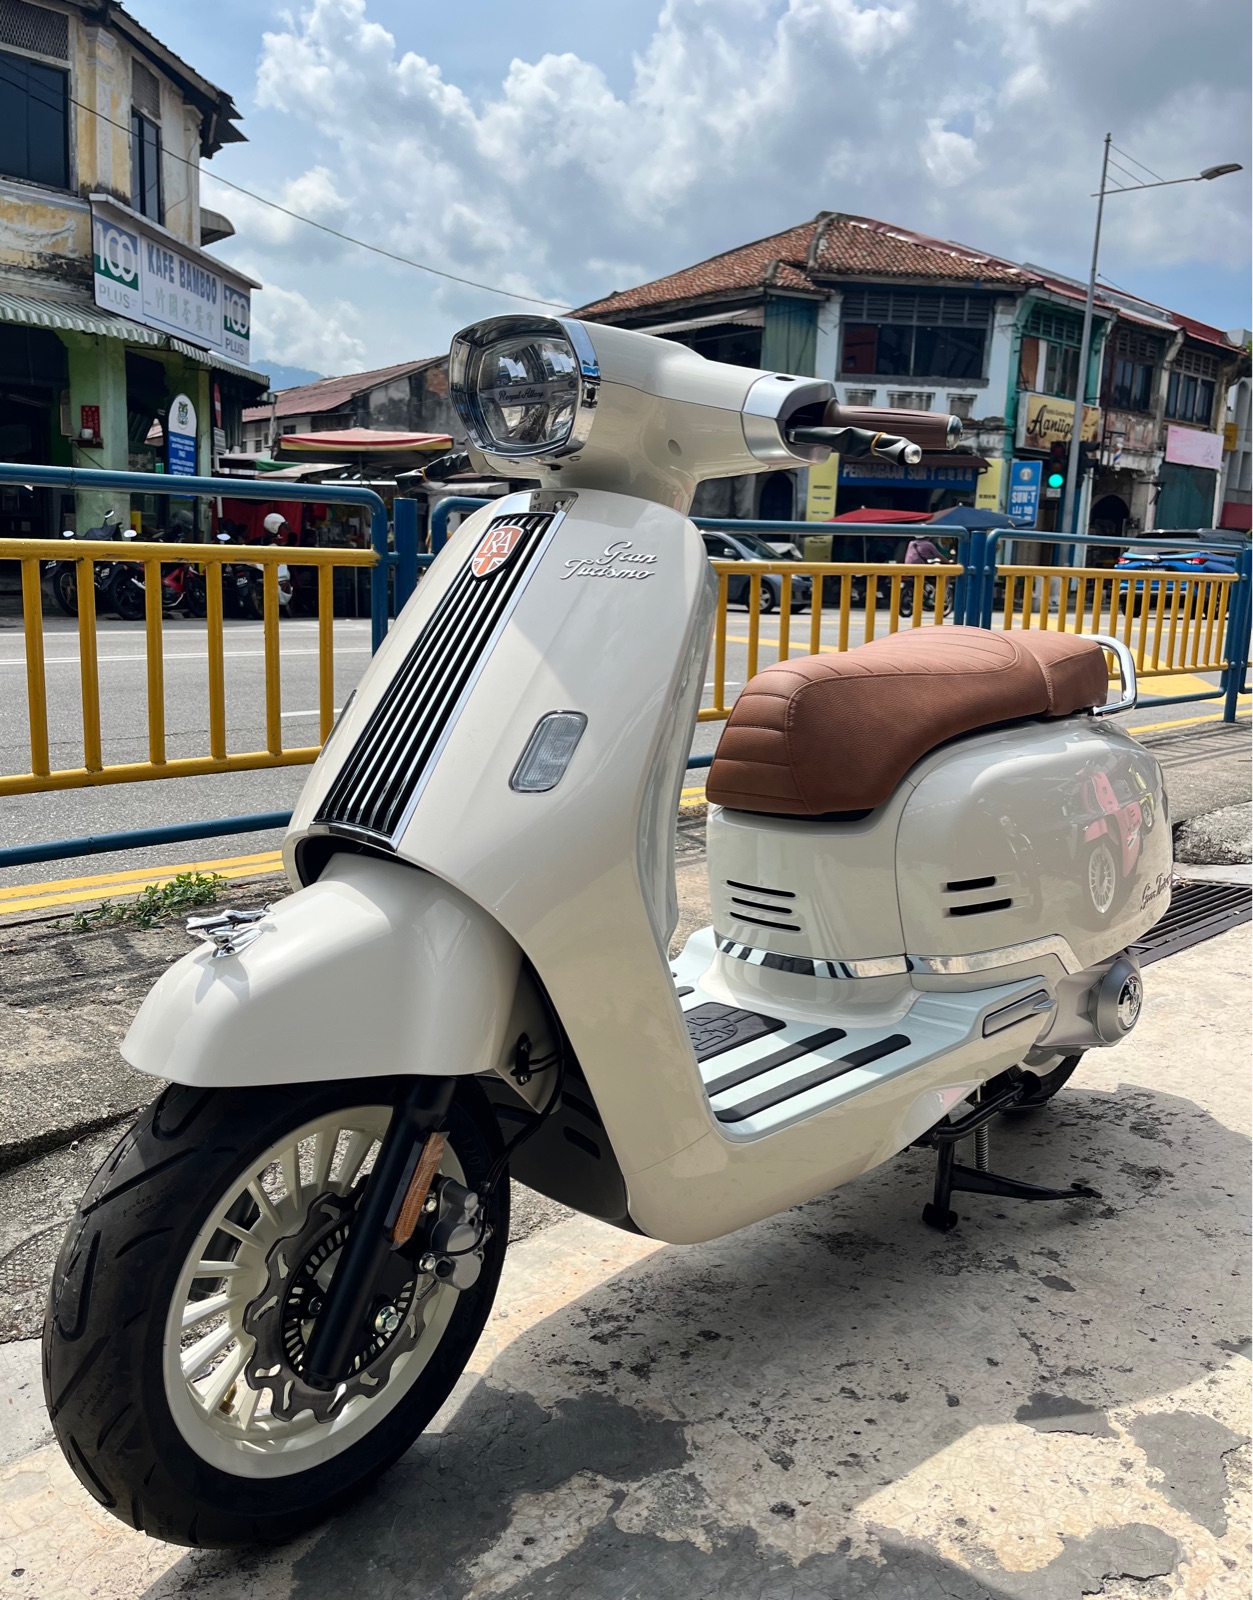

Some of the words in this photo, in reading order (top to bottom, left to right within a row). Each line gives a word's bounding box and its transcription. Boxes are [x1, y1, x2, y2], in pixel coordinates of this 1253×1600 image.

[96, 222, 137, 282] 100
[147, 241, 175, 284] KAFE
[179, 259, 217, 305] BAMBOO
[98, 283, 131, 310] PLUS
[224, 289, 249, 334] 100
[225, 336, 245, 357] PLUS
[498, 389, 521, 403] Royal
[522, 388, 544, 400] Alloy
[596, 540, 658, 565] Gran
[560, 558, 656, 580] Turismo
